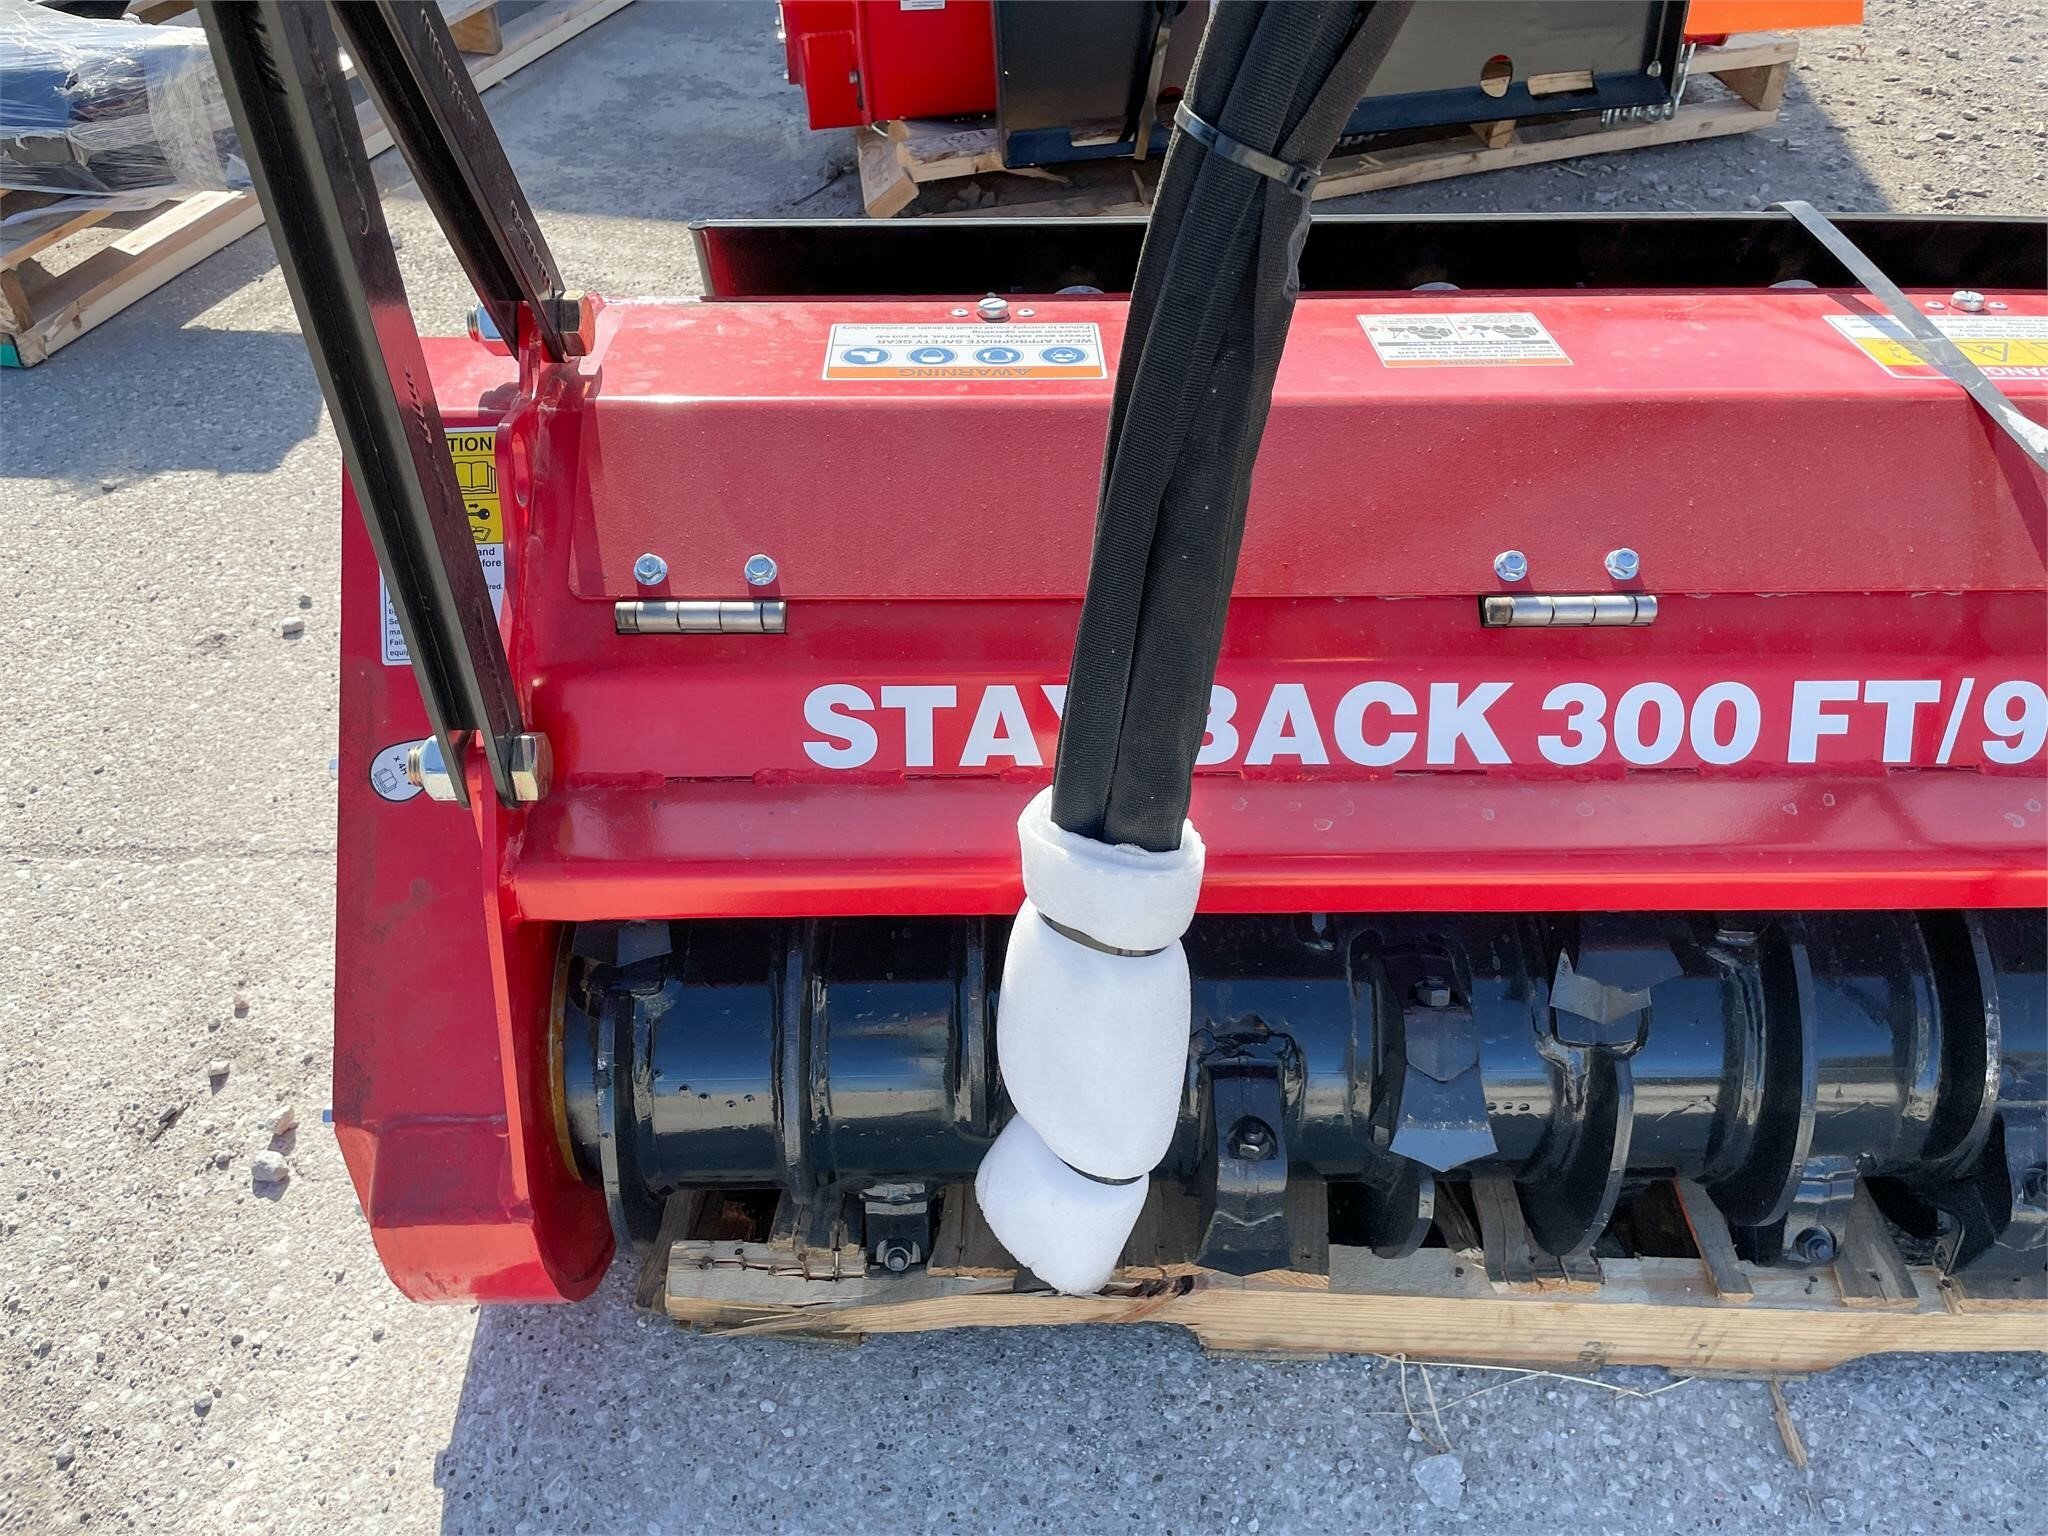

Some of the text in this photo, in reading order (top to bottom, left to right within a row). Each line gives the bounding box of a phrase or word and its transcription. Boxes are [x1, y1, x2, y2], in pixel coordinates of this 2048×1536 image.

[898, 368, 1013, 377] WARNING
[447, 436, 492, 452] TION
[482, 559, 502, 567] fore
[1538, 682, 1761, 766] 300
